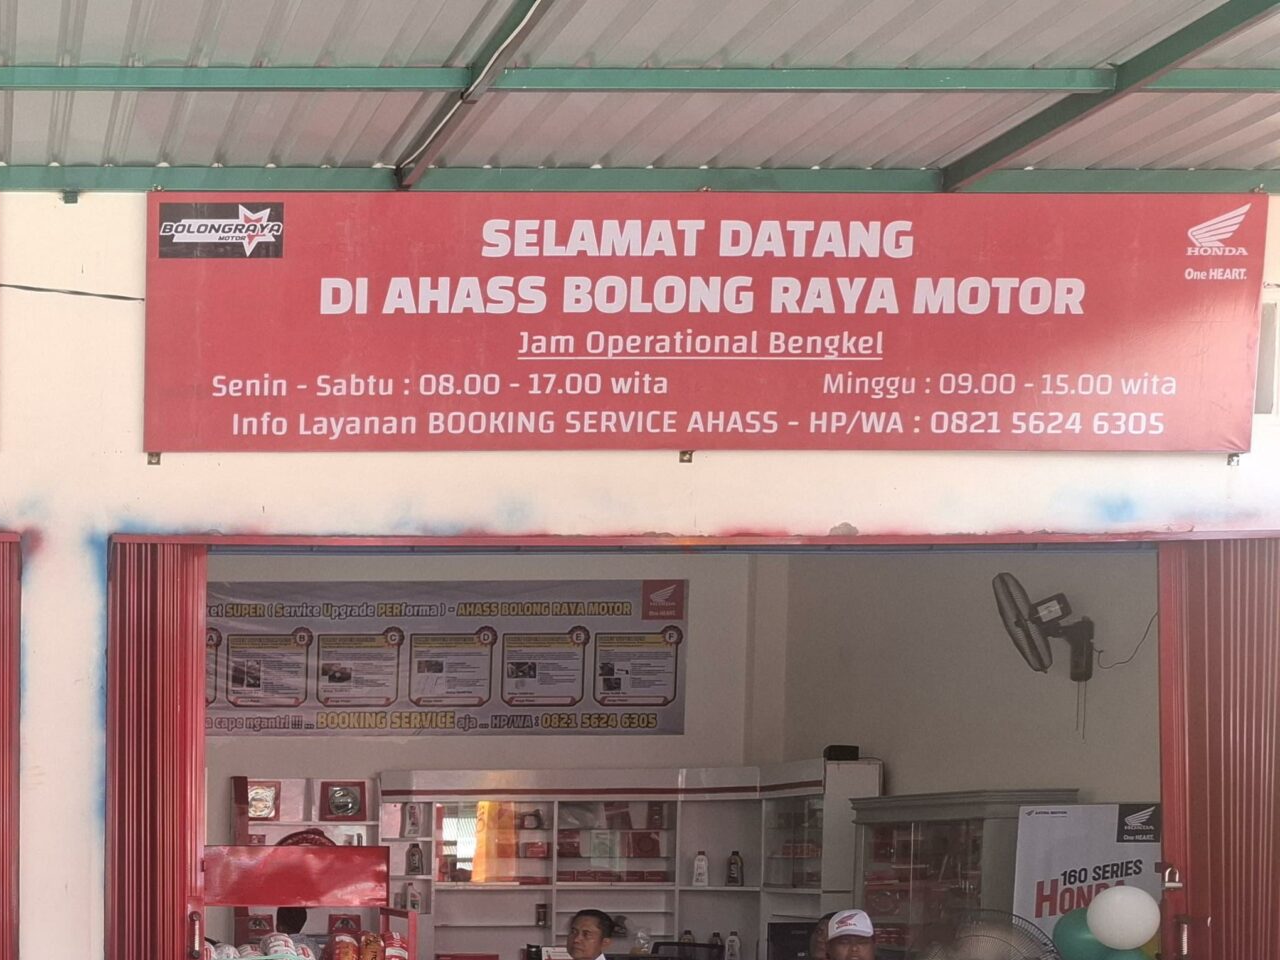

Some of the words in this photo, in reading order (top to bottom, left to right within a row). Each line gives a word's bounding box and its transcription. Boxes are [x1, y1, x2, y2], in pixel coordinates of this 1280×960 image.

[161, 223, 282, 235] BOLONGRAYA
[480, 218, 705, 258] SELAMAT
[719, 219, 914, 258] DATANG
[1185, 246, 1248, 256] HONDA
[1184, 267, 1207, 280] One
[1209, 267, 1248, 280] HEART.
[319, 276, 369, 315] DI
[381, 276, 548, 315] AHASS
[562, 276, 754, 315] BOLONG
[770, 276, 900, 315] RAYA
[912, 276, 1086, 315] MOTOR
[517, 331, 575, 355] Jam
[586, 331, 758, 357] Operational
[769, 330, 884, 358] Bengkel
[212, 374, 287, 397] Senin
[316, 373, 393, 397] Sabtu
[419, 373, 501, 396] 08.00
[528, 373, 602, 396] 17.00
[611, 373, 669, 395] wita
[823, 372, 916, 399] Minggu
[939, 373, 1016, 395] 09.00
[1040, 373, 1113, 396] 15.00
[1120, 373, 1177, 396] wita
[232, 412, 289, 437] Info
[298, 413, 417, 440] Layanan
[428, 411, 555, 435] BOOKING
[564, 410, 678, 434] SERVICE
[686, 410, 779, 434] AHASS
[809, 410, 904, 435] HP/WA
[930, 410, 1001, 434] 0821
[1011, 411, 1083, 435] 5624
[1092, 411, 1165, 435] 6305
[206, 603, 223, 618] et
[226, 603, 265, 618] SUPER
[275, 603, 320, 618] Service
[323, 603, 374, 620] Upgrade
[377, 602, 439, 618] PERforma
[456, 601, 499, 617] AHASS
[500, 601, 551, 617] BOLONG
[551, 601, 586, 617] RAYA
[586, 601, 632, 617] MOTOR
[298, 634, 306, 643] B
[389, 633, 397, 642] C
[482, 632, 490, 641] D
[575, 632, 582, 641] E
[668, 632, 675, 641] F
[215, 716, 244, 732] cape
[245, 714, 290, 732] ngantri
[316, 711, 387, 729] BOOKING
[390, 711, 455, 729] SERVICE
[457, 715, 478, 732] aja
[491, 714, 534, 729] HP/WA
[541, 713, 578, 729] 0821
[580, 713, 619, 729] 5624
[621, 713, 657, 729] 6305
[1060, 867, 1088, 886] 160
[1092, 859, 1143, 882] SERIES
[1034, 879, 1125, 919] HON
